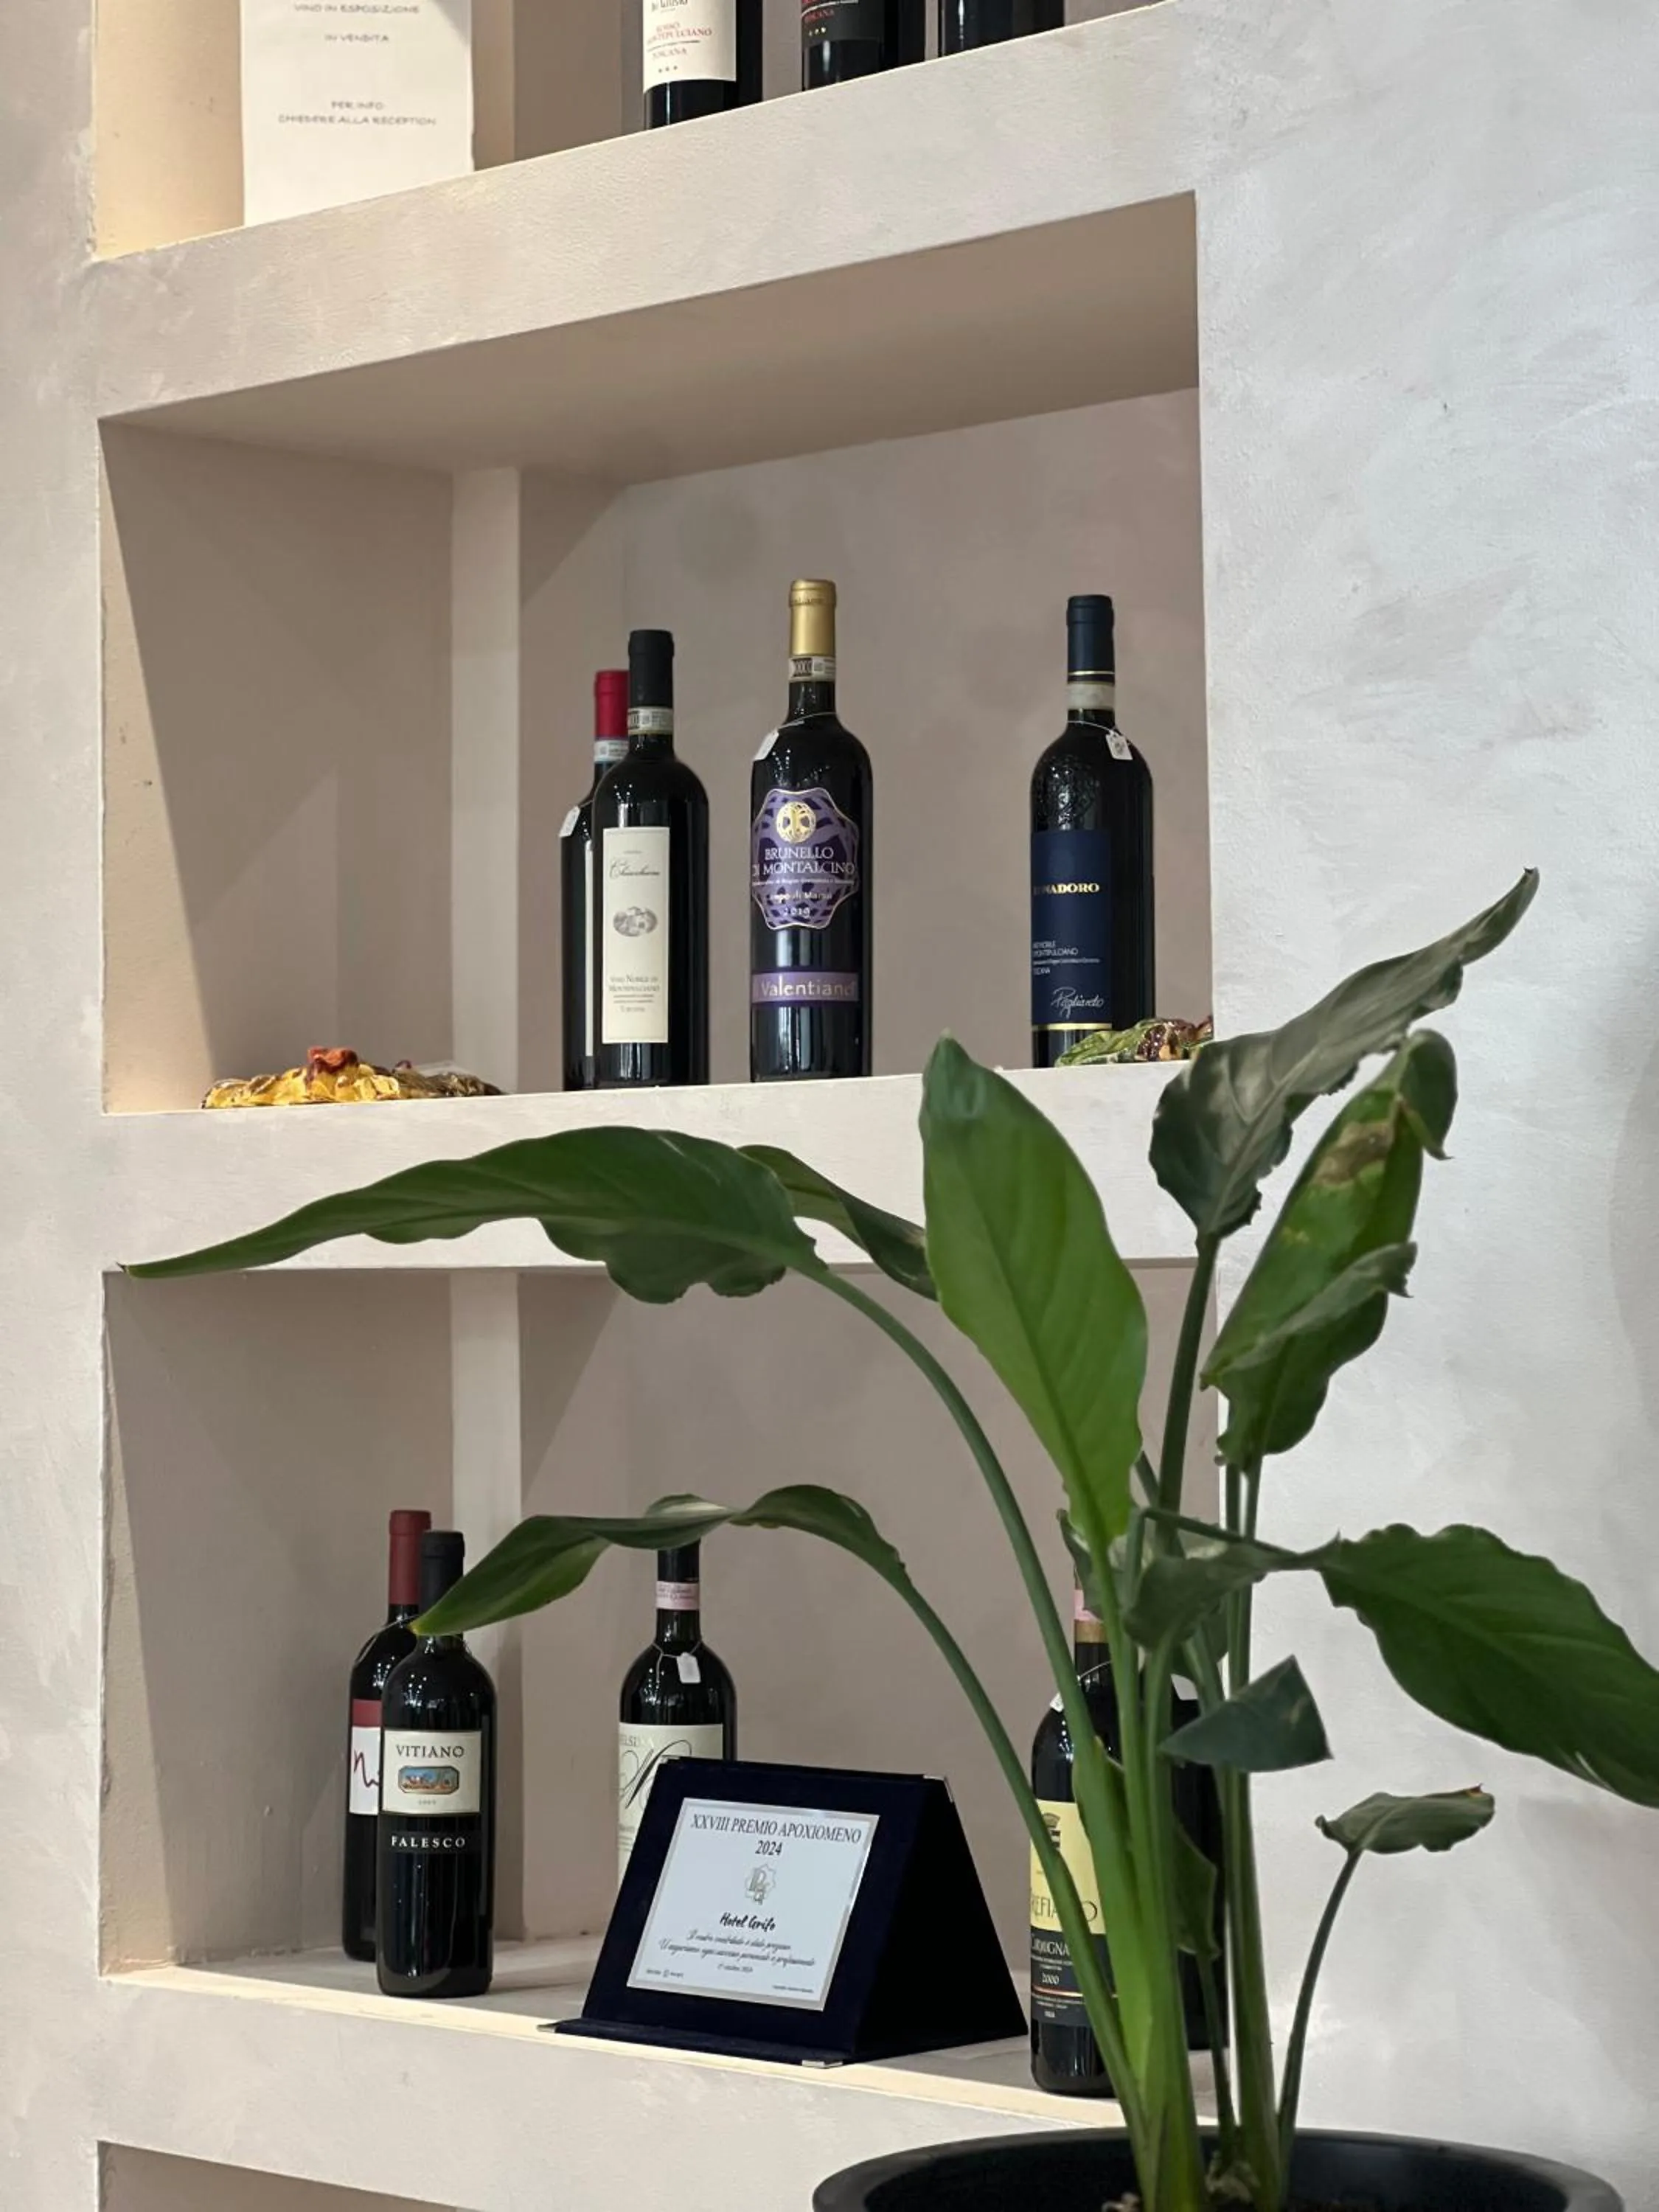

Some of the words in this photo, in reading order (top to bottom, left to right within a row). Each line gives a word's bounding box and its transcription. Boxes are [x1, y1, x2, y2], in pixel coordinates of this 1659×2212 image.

[294, 4, 322, 13] VINO
[340, 4, 420, 13] ESPOSIZIONE
[340, 34, 390, 42] VENDITA
[331, 100, 353, 110] PER
[338, 116, 369, 125] ALLA
[372, 116, 437, 126] RECEPTION
[765, 848, 834, 860] BRUNELLO
[763, 861, 855, 876] MONTALCINO
[397, 1745, 465, 1758] VITIANO
[690, 1813, 730, 1832] XXVIII
[731, 1818, 778, 1835] PREMIO
[779, 1823, 862, 1844] APOXIOMENO
[392, 1836, 465, 1848] FALESCO
[755, 1840, 783, 1856] 2024
[719, 1911, 749, 1928] Hotel
[748, 1915, 776, 1932] Grifo
